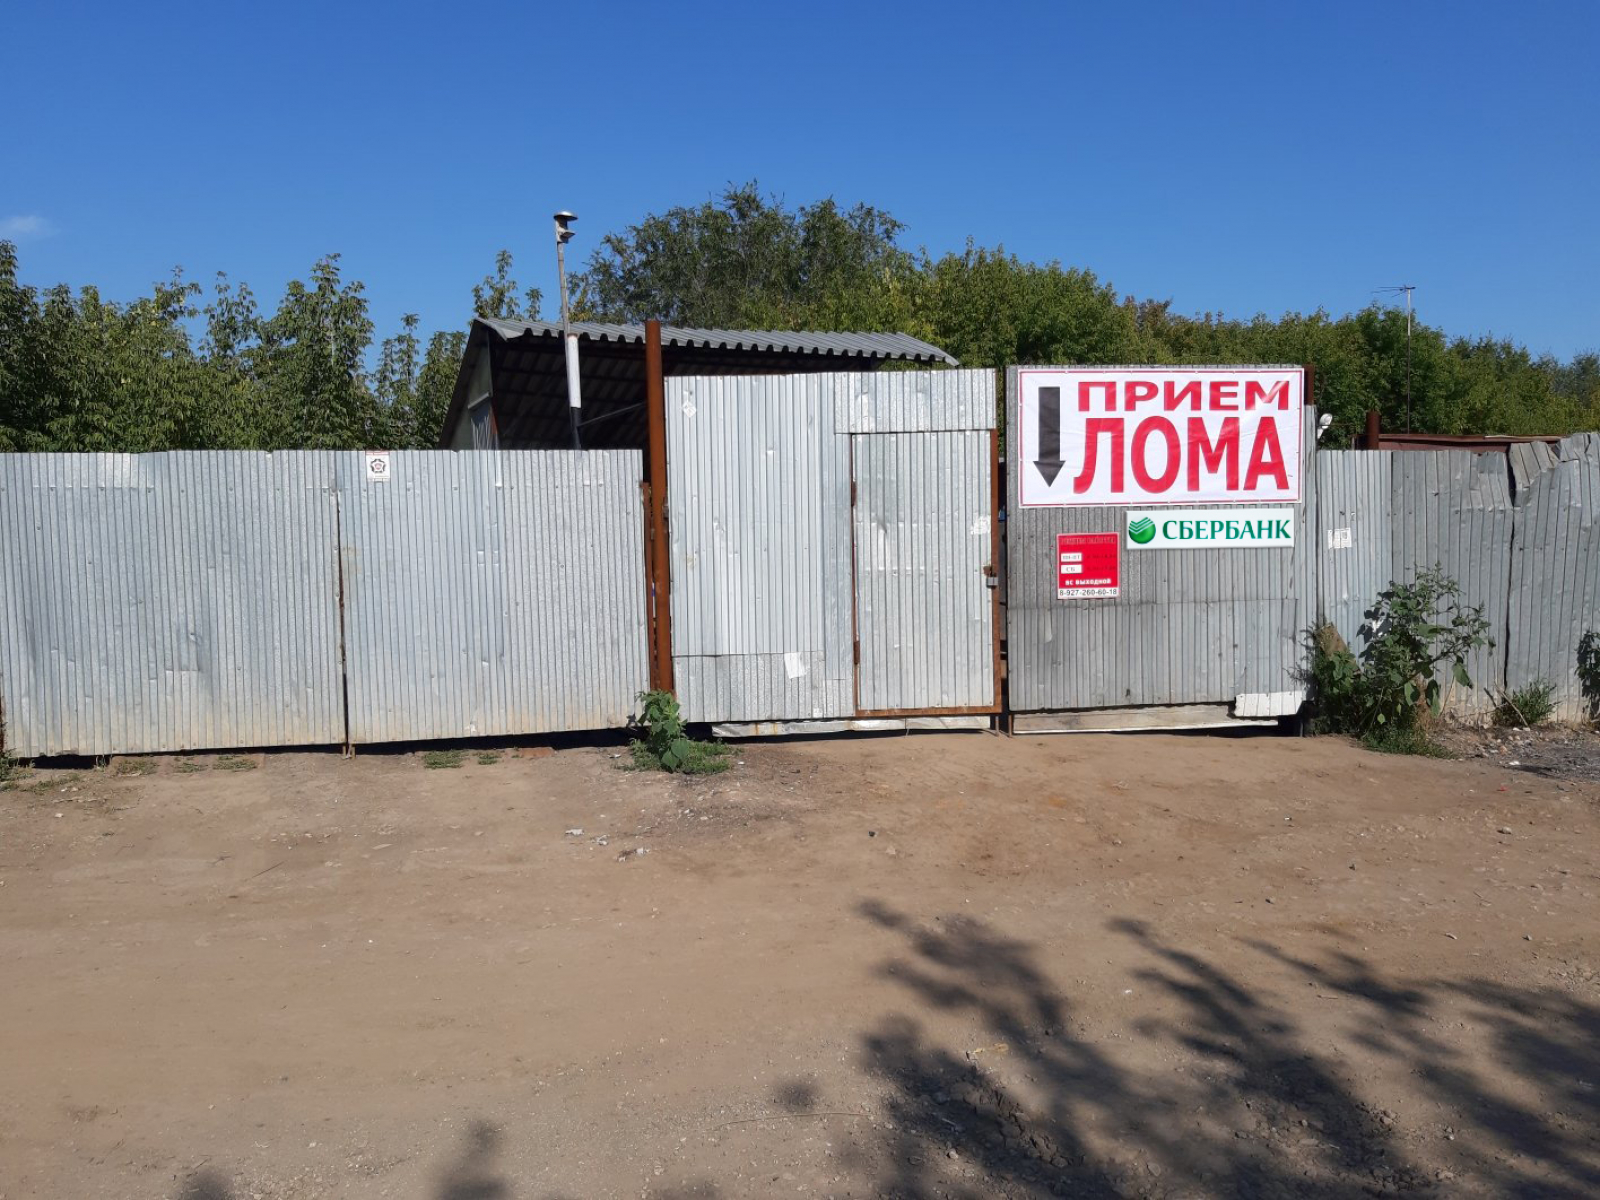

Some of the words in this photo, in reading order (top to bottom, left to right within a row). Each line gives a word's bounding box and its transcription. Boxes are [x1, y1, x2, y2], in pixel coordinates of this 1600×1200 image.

[1078, 381, 1289, 412] ПРИЕМ
[1073, 416, 1289, 494] ЛОМА
[1162, 519, 1291, 540] СБЕРБАНК
